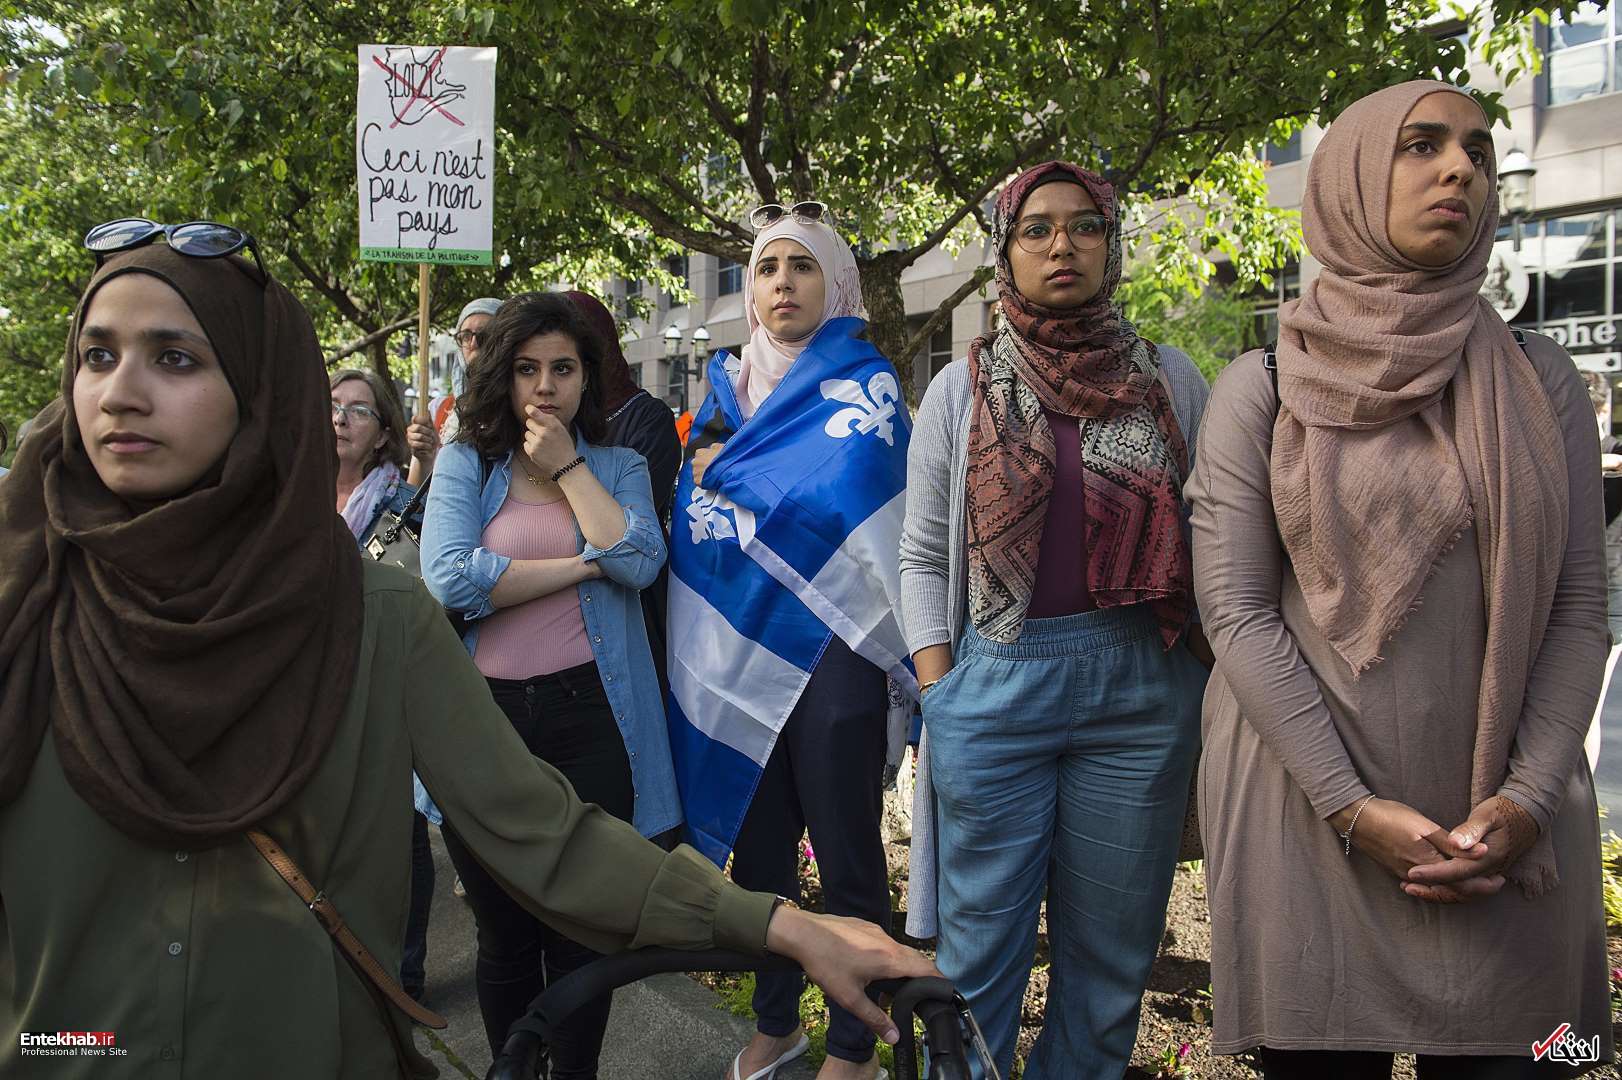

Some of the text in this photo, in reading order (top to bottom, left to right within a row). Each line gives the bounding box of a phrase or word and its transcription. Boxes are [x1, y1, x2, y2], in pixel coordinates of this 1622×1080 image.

[361, 122, 486, 179] Ceci n'est
[369, 176, 482, 222] pas mon
[397, 211, 458, 251] pays
[415, 251, 425, 260] DE
[427, 252, 436, 260] LA
